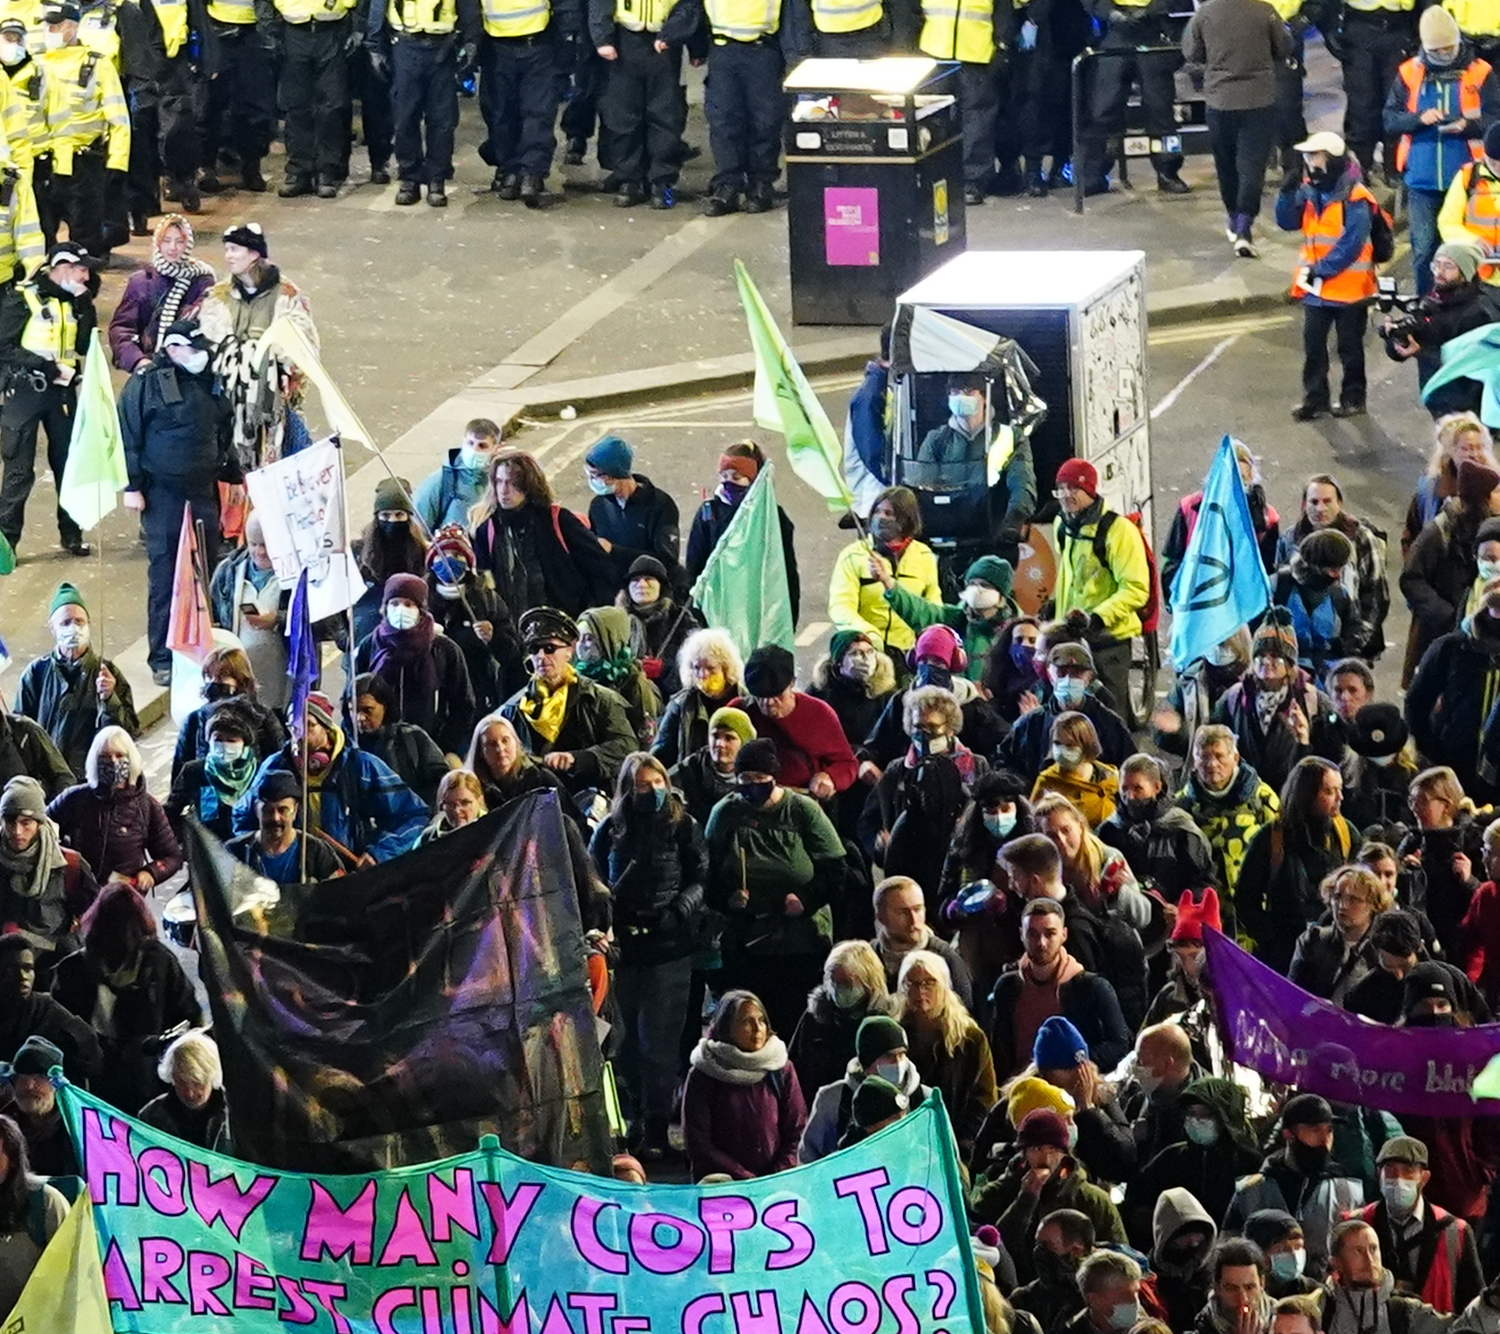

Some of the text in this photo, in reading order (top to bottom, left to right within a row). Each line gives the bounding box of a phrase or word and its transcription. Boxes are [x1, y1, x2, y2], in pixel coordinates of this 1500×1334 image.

[83, 1107, 943, 1275] HOW MANY COPS TO
